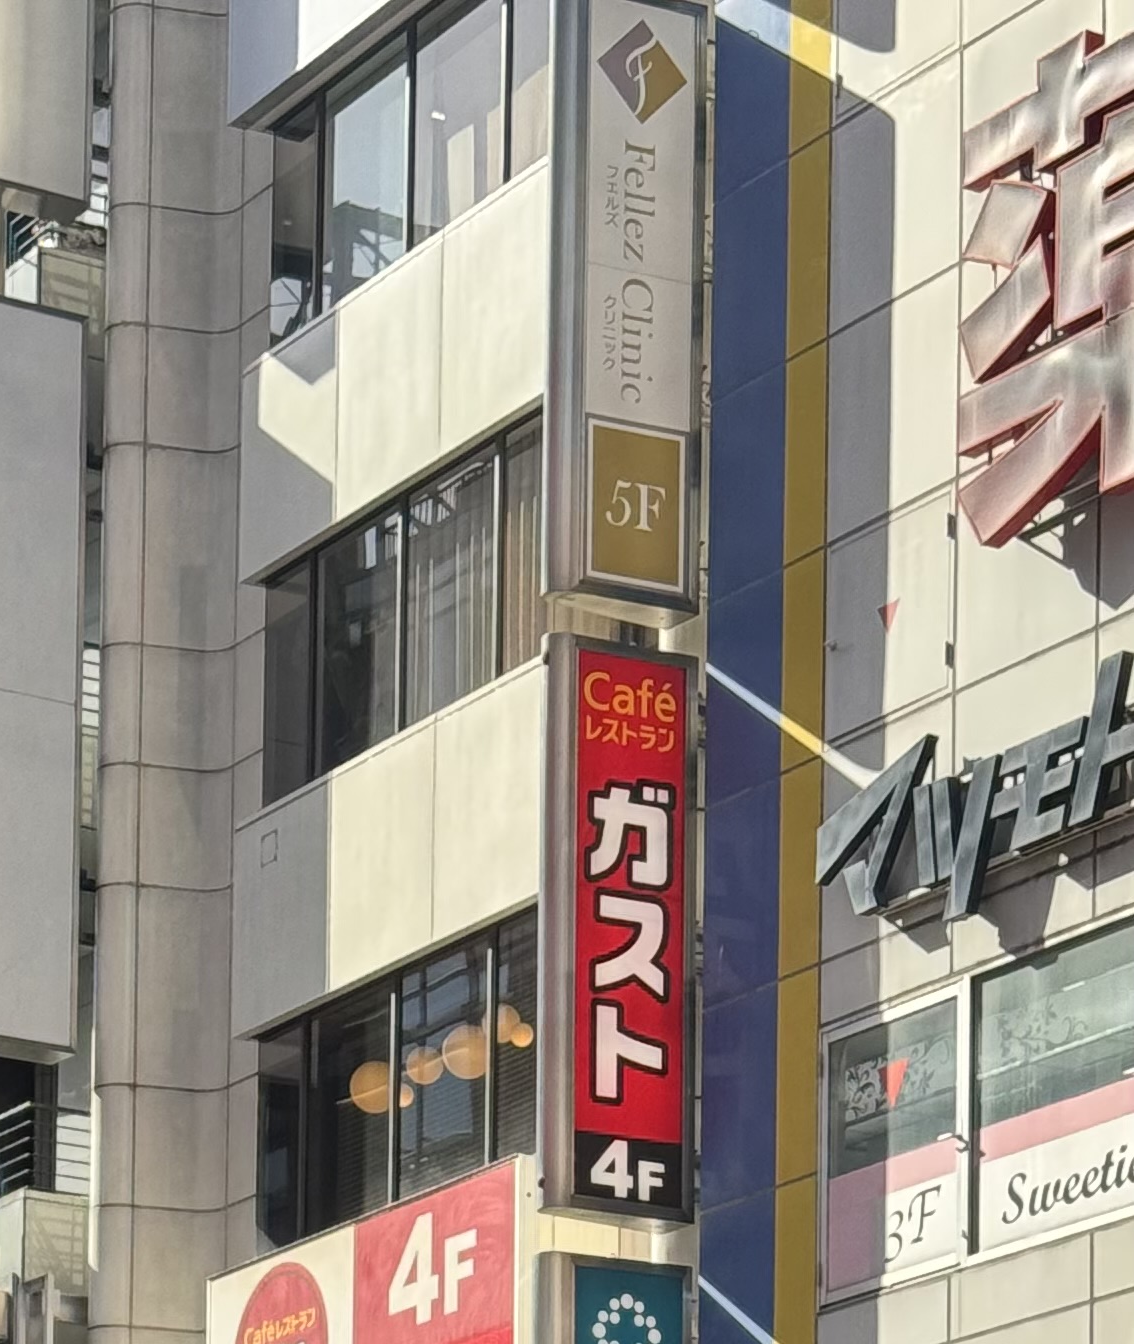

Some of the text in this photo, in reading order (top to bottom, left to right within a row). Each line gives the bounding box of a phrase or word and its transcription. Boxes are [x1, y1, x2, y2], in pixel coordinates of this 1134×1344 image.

[620, 140, 656, 404] Fellez Clinic
[605, 480, 666, 532] 5F
[583, 671, 677, 723] Café
[585, 715, 675, 753] レストラン
[585, 784, 670, 1100] ガスト
[590, 1139, 666, 1202] 4F
[1001, 1143, 1134, 1226] Sweeti
[388, 1211, 478, 1327] 4F
